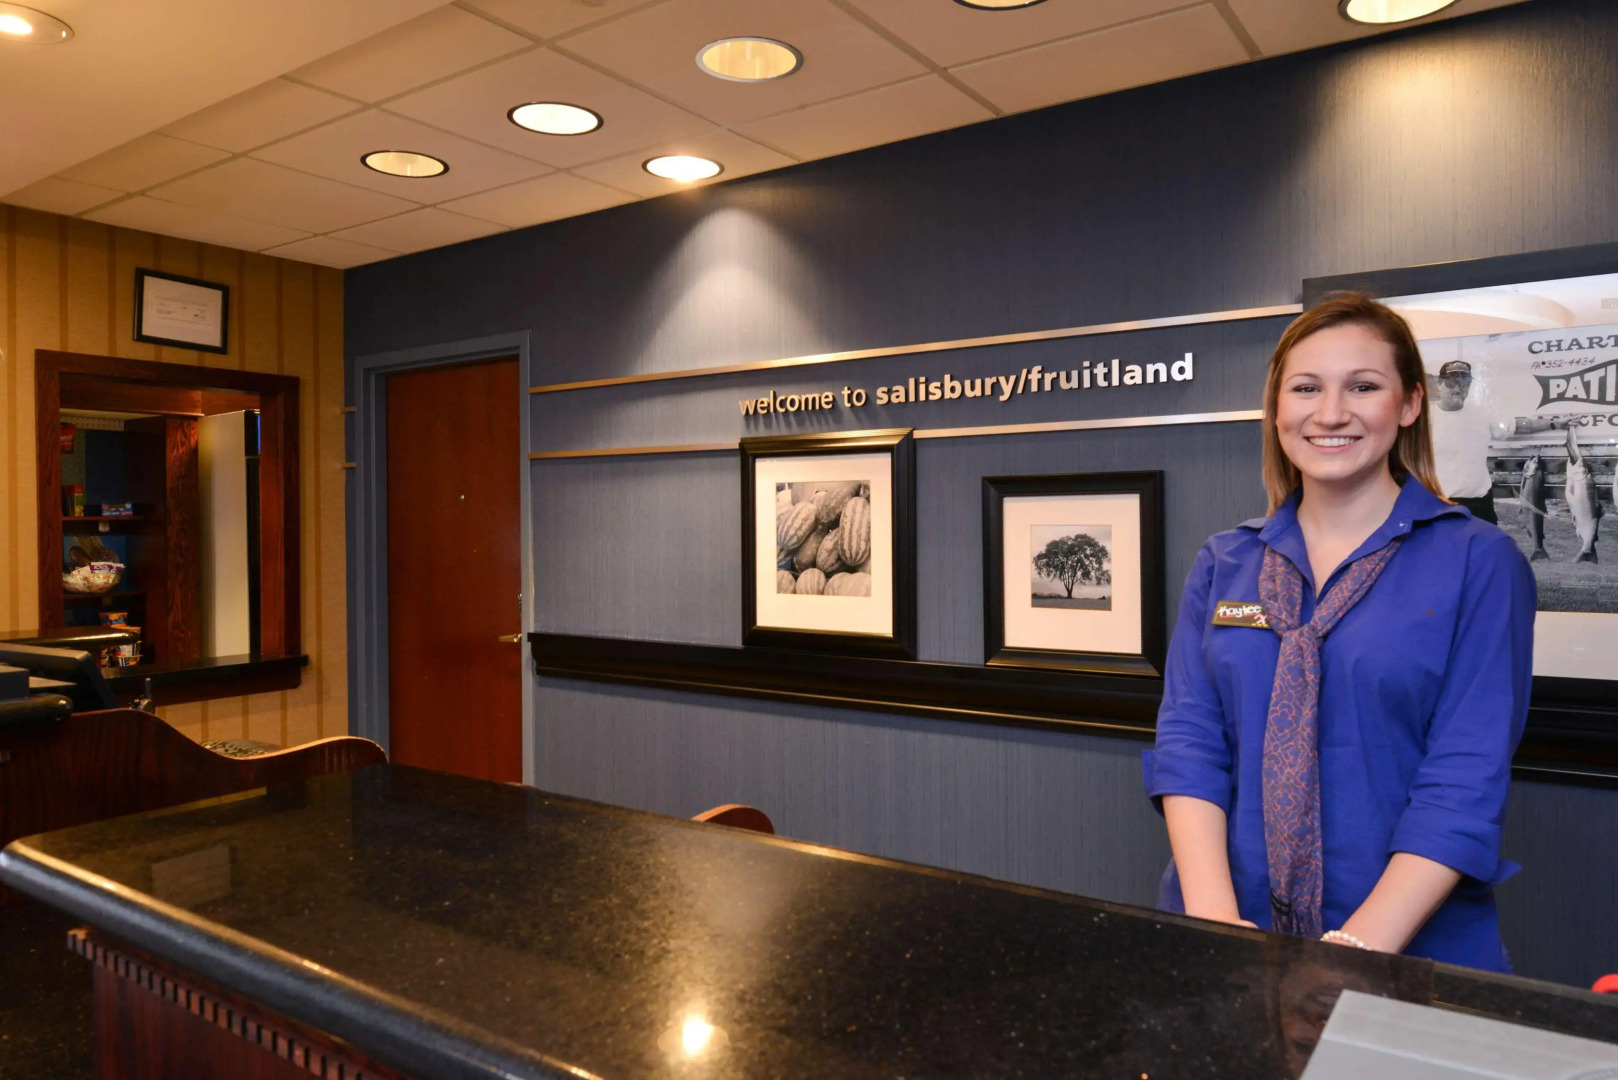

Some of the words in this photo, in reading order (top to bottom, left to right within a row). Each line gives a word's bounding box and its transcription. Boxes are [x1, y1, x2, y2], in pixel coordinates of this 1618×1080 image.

[738, 389, 834, 416] welcome
[843, 385, 867, 408] to
[875, 352, 1195, 405] salisbury/fruitland
